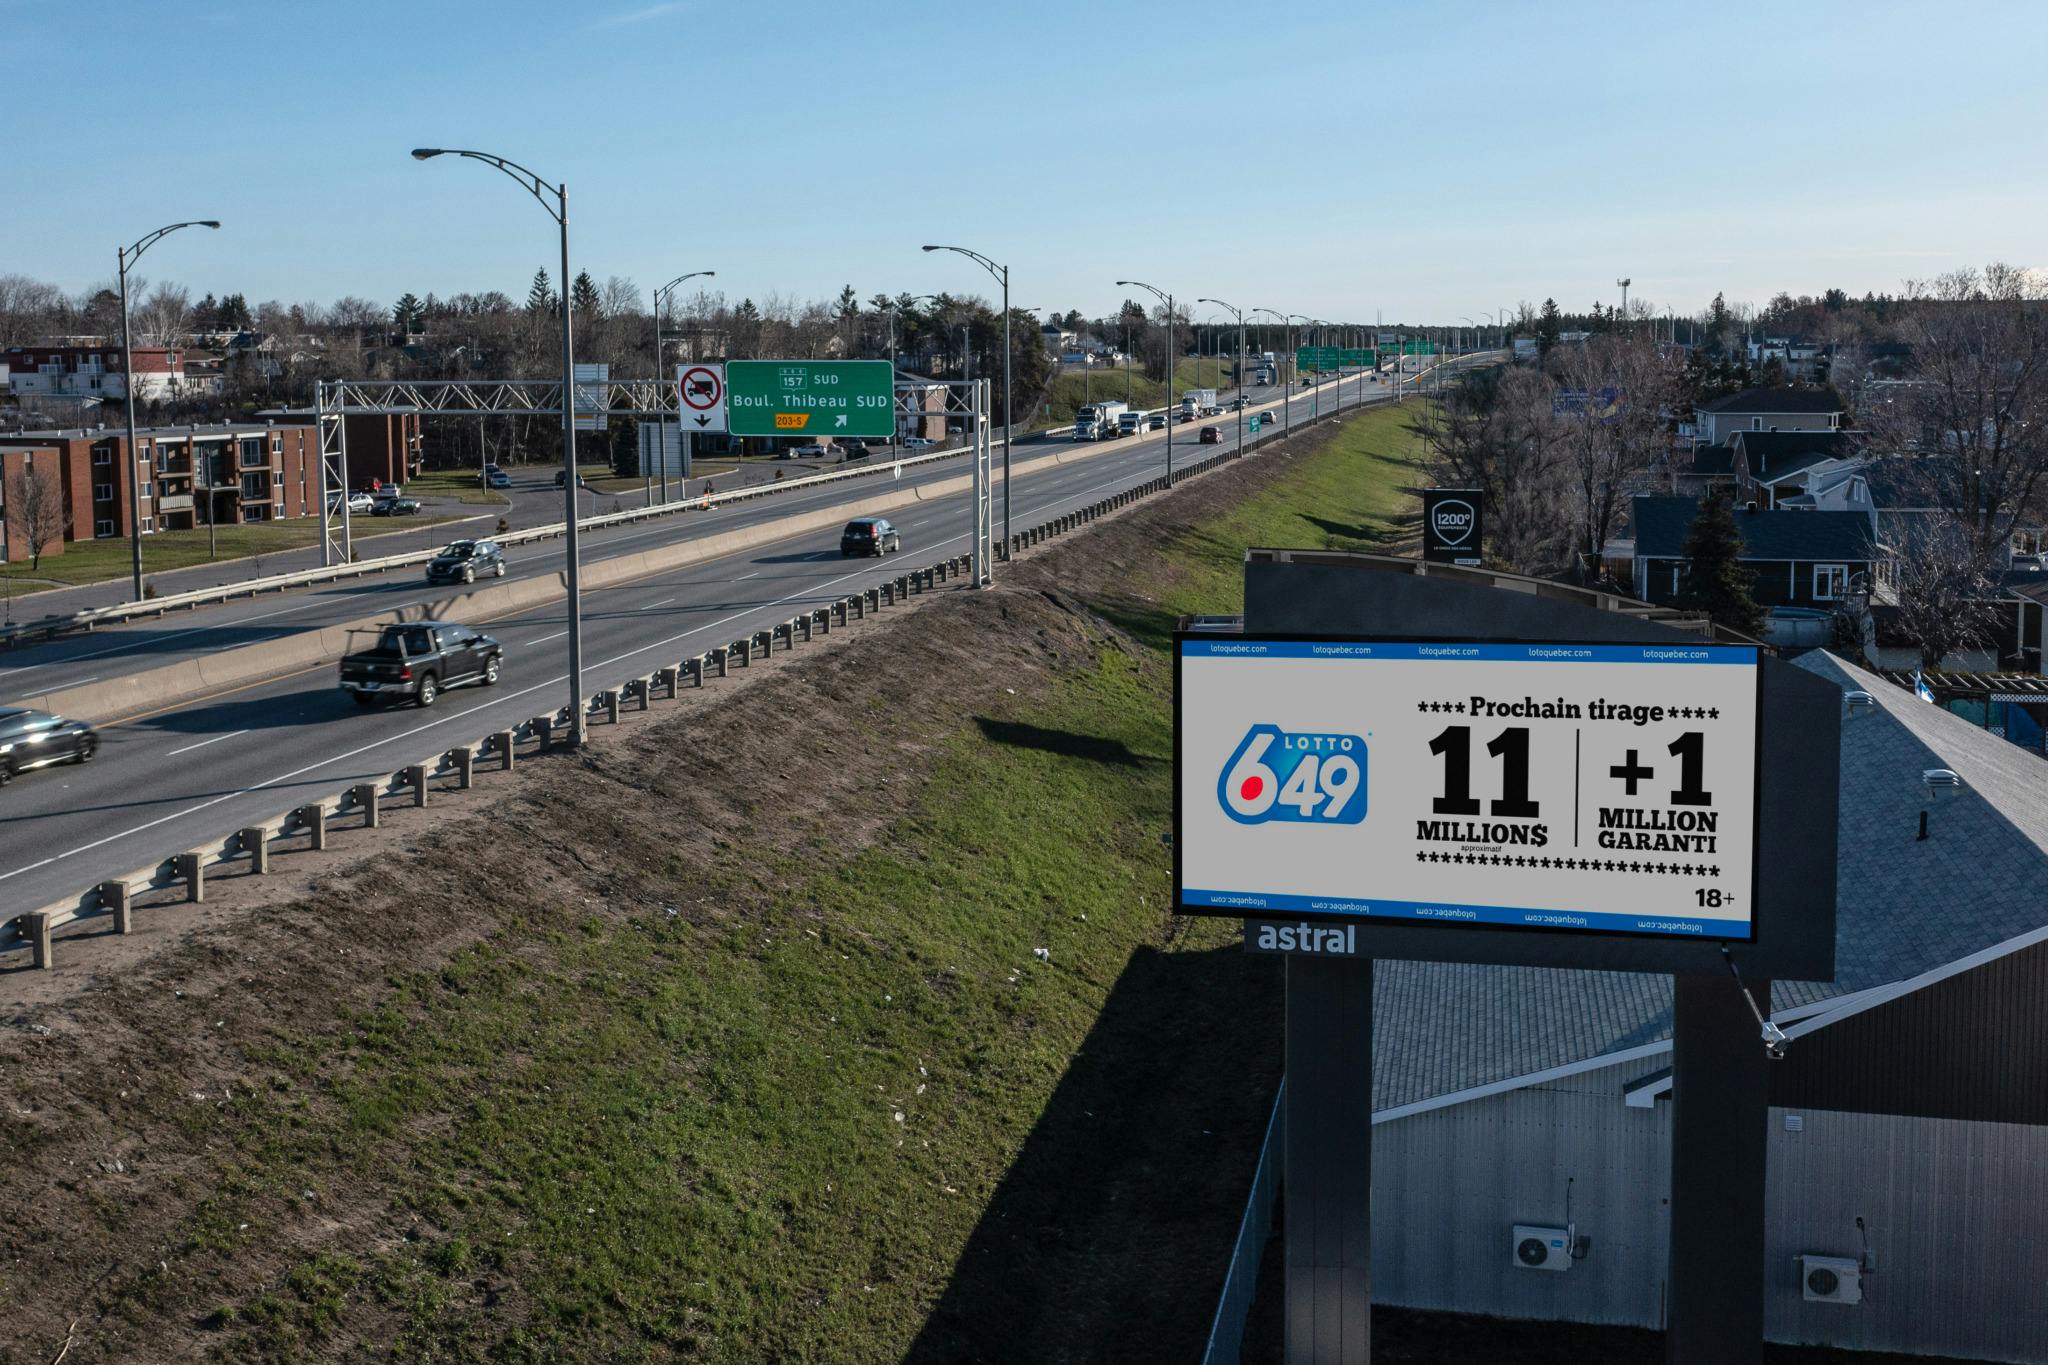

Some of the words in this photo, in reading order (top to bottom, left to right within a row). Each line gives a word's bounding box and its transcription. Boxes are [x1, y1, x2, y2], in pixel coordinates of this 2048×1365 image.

[783, 377, 803, 386] 157
[814, 375, 839, 385] SUD
[734, 395, 774, 407] Boul.
[783, 395, 847, 407] Thibeau
[857, 395, 887, 407] SUD
[776, 416, 803, 426] 203-S
[1210, 644, 1267, 654] lotoquebec.com
[1312, 645, 1372, 656] lotoquebec.com
[1418, 646, 1479, 657] lotoquebec.com
[1528, 648, 1592, 659] lotoquebec.com
[1643, 649, 1709, 661] lotoquebec.com
[1470, 696, 1582, 719] Prochain
[1588, 698, 1664, 726] tirage
[1285, 737, 1353, 751] LOTTO
[1428, 725, 1540, 818] 11
[1598, 807, 1718, 832] MILLION
[1416, 820, 1548, 848] MILLION$
[1598, 830, 1717, 853] GARANTI
[1460, 844, 1502, 853] approximatif
[1210, 896, 1267, 906] lotoquebec.com
[1695, 888, 1735, 908] 18+
[1311, 902, 1369, 912] lotoquebec.com
[1416, 908, 1476, 919] lotoquebec.com
[1525, 915, 1587, 926] lotoquebec.com
[1638, 921, 1702, 933] lotoquebec.com
[1258, 922, 1356, 954] astral
